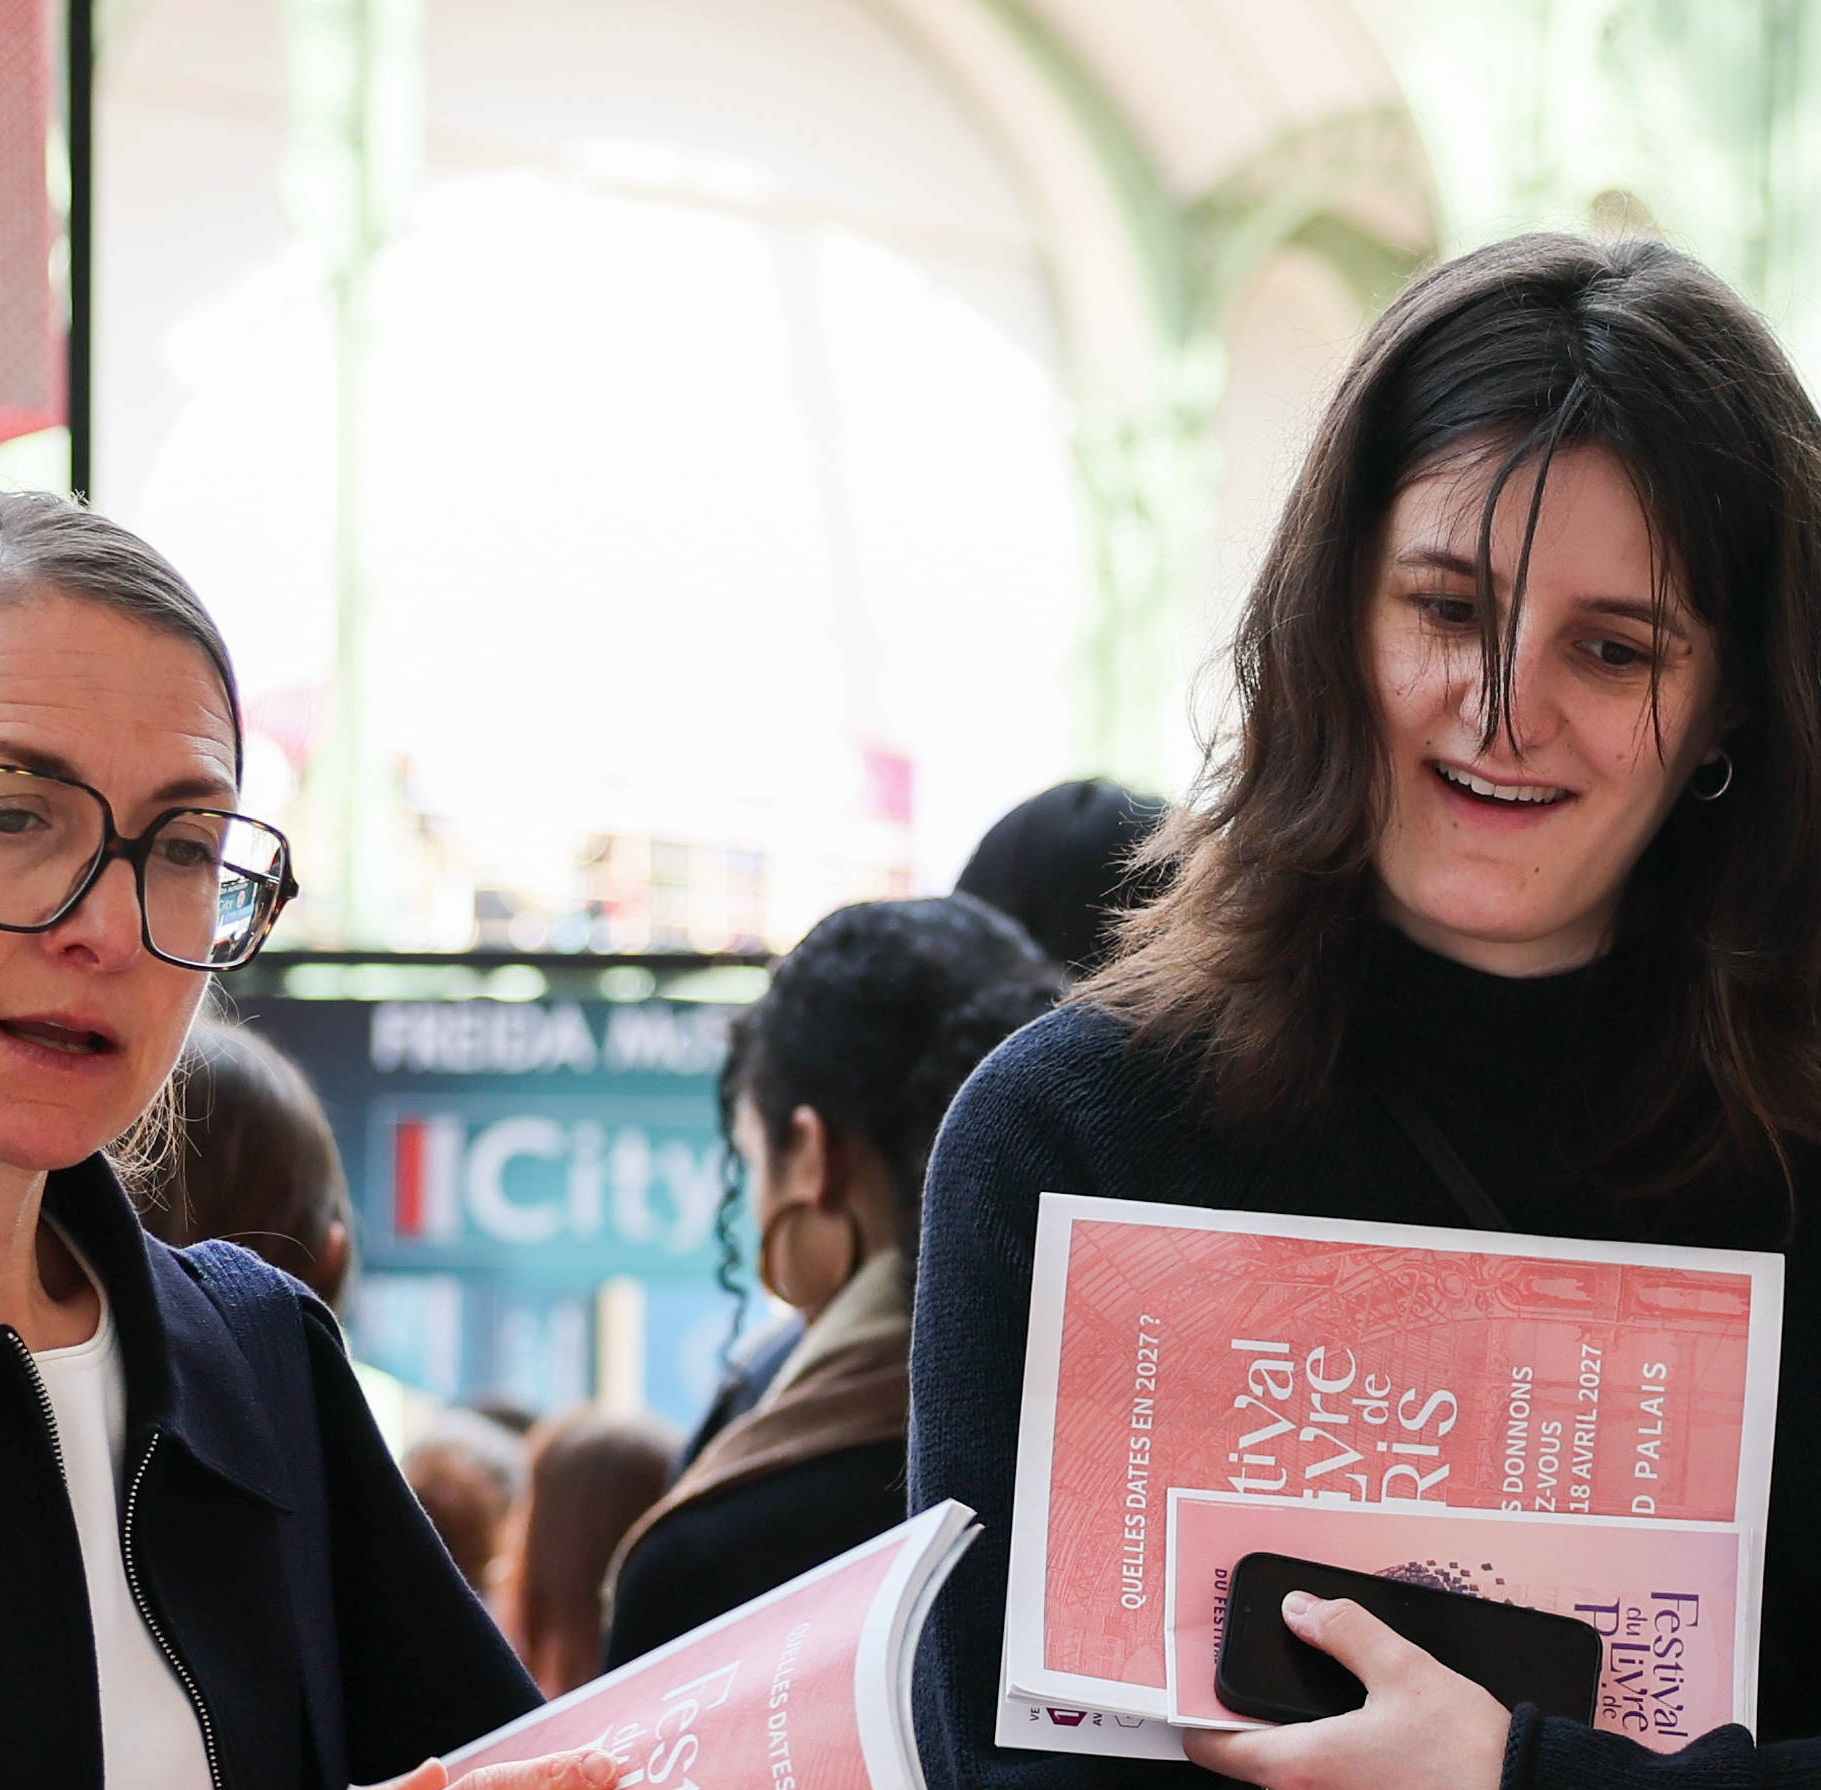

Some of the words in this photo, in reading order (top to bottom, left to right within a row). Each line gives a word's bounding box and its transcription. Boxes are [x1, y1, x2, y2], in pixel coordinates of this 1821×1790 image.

[468, 1113, 726, 1256] City
[1140, 1314, 1161, 1325] ?
[1135, 1332, 1160, 1392] 2027
[1353, 1373, 1391, 1424] de
[1579, 1343, 1602, 1402] 2027
[1133, 1397, 1156, 1429] EN
[1228, 1339, 1296, 1495] tival
[1299, 1345, 1369, 1501] ivre
[1502, 1366, 1533, 1494] DONNONS
[1573, 1410, 1597, 1482] AVRIL
[1634, 1362, 1667, 1480] PALAIS
[1125, 1437, 1152, 1511] DATES
[1535, 1420, 1563, 1512] Z-VOUS
[1121, 1513, 1149, 1610] QUELLES
[1214, 1568, 1228, 1591] DU
[1626, 1608, 1647, 1636] du
[770, 1622, 812, 1709] QUELLES
[1610, 1643, 1651, 1732] Livre
[1650, 1592, 1699, 1737] Festival
[1030, 1707, 1040, 1721] VE
